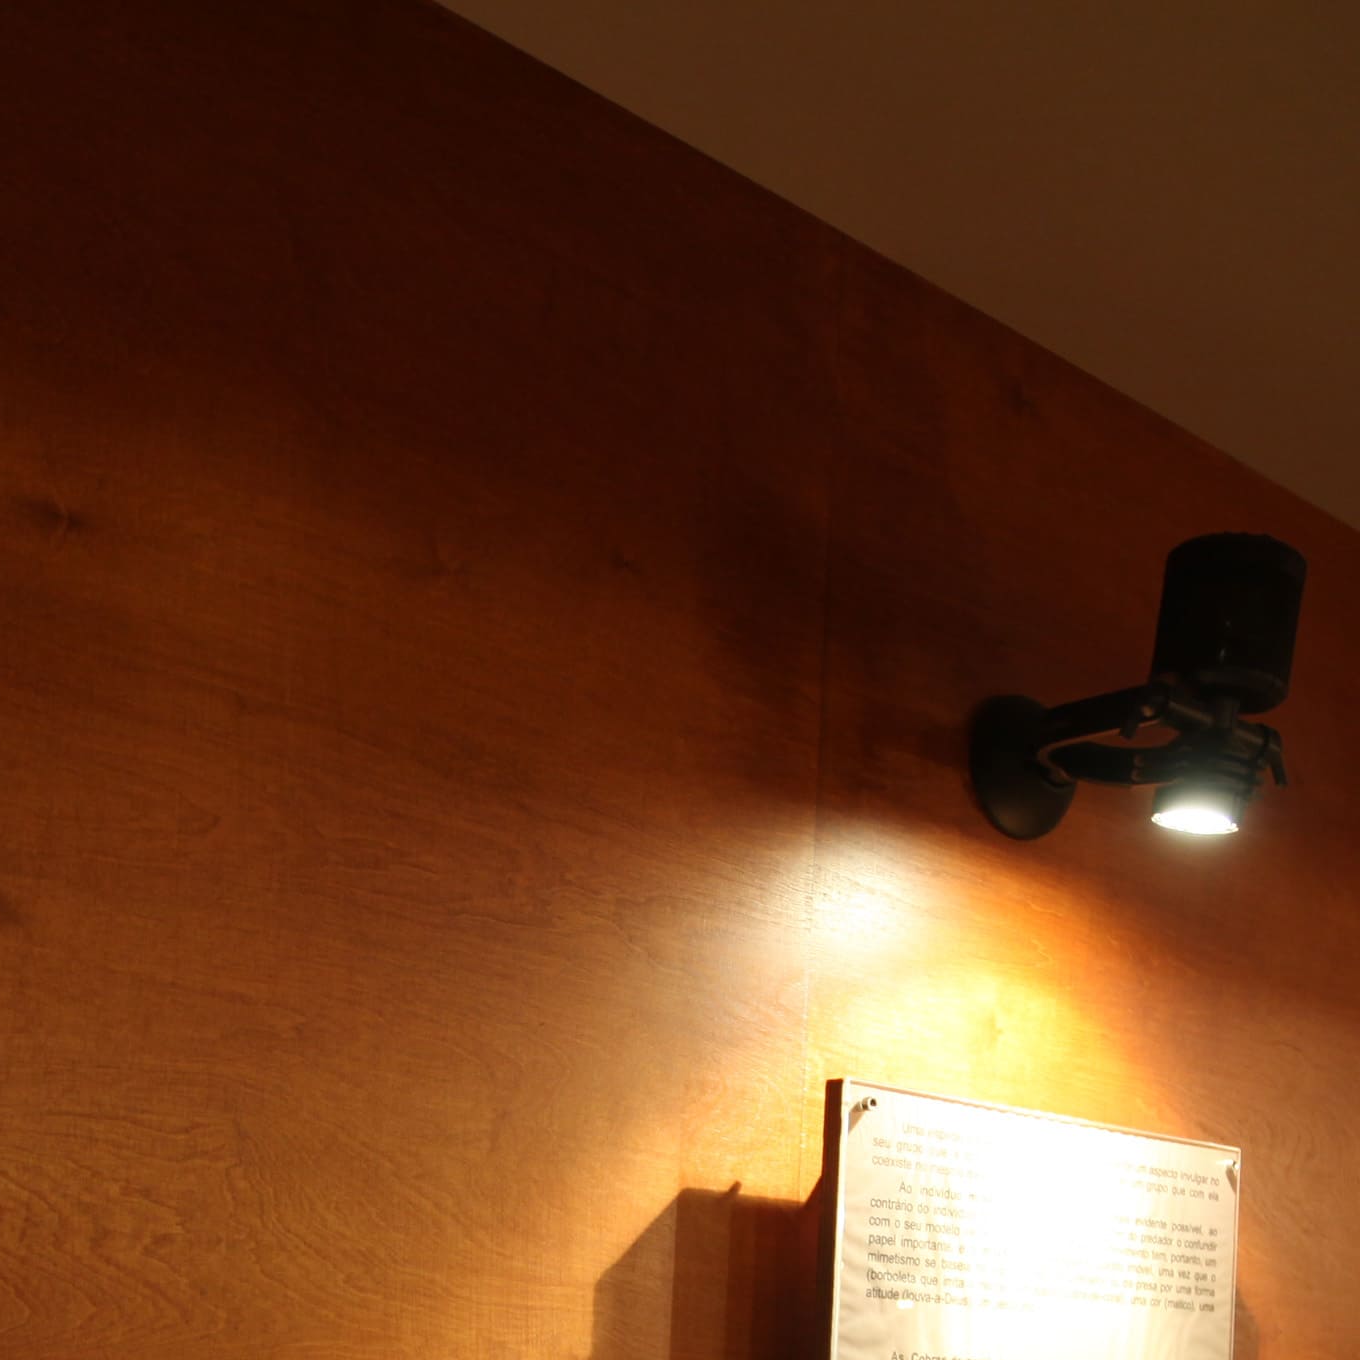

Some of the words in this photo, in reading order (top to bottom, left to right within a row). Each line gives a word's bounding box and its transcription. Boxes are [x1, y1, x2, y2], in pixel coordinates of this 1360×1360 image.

[872, 1155, 912, 1170] coexiste
[872, 1137, 891, 1148] seu
[1172, 1186, 1185, 1197] que
[1189, 1189, 1204, 1198] com
[1180, 1171, 1209, 1186] invulgar
[1211, 1176, 1220, 1186] no
[870, 1197, 913, 1213] contrário
[1184, 1238, 1217, 1251] confundir
[899, 1181, 912, 1194] Ao
[1209, 1227, 1218, 1236] ao
[869, 1216, 890, 1227] com
[904, 1220, 921, 1231] seu
[1205, 1258, 1216, 1266] um
[869, 1232, 896, 1248] papel
[1159, 1267, 1174, 1277] uma
[1178, 1270, 1190, 1279] vez
[1194, 1271, 1207, 1283] que
[866, 1268, 916, 1285] (borboleta
[921, 1275, 938, 1288] que
[1199, 1303, 1215, 1312] uma
[866, 1287, 899, 1300] atitude
[867, 1250, 921, 1266] mimetismo
[925, 1258, 936, 1268] se
[1136, 1281, 1157, 1292] presa
[1160, 1283, 1172, 1294] por
[1176, 1285, 1191, 1294] uma
[1195, 1286, 1215, 1297] forma
